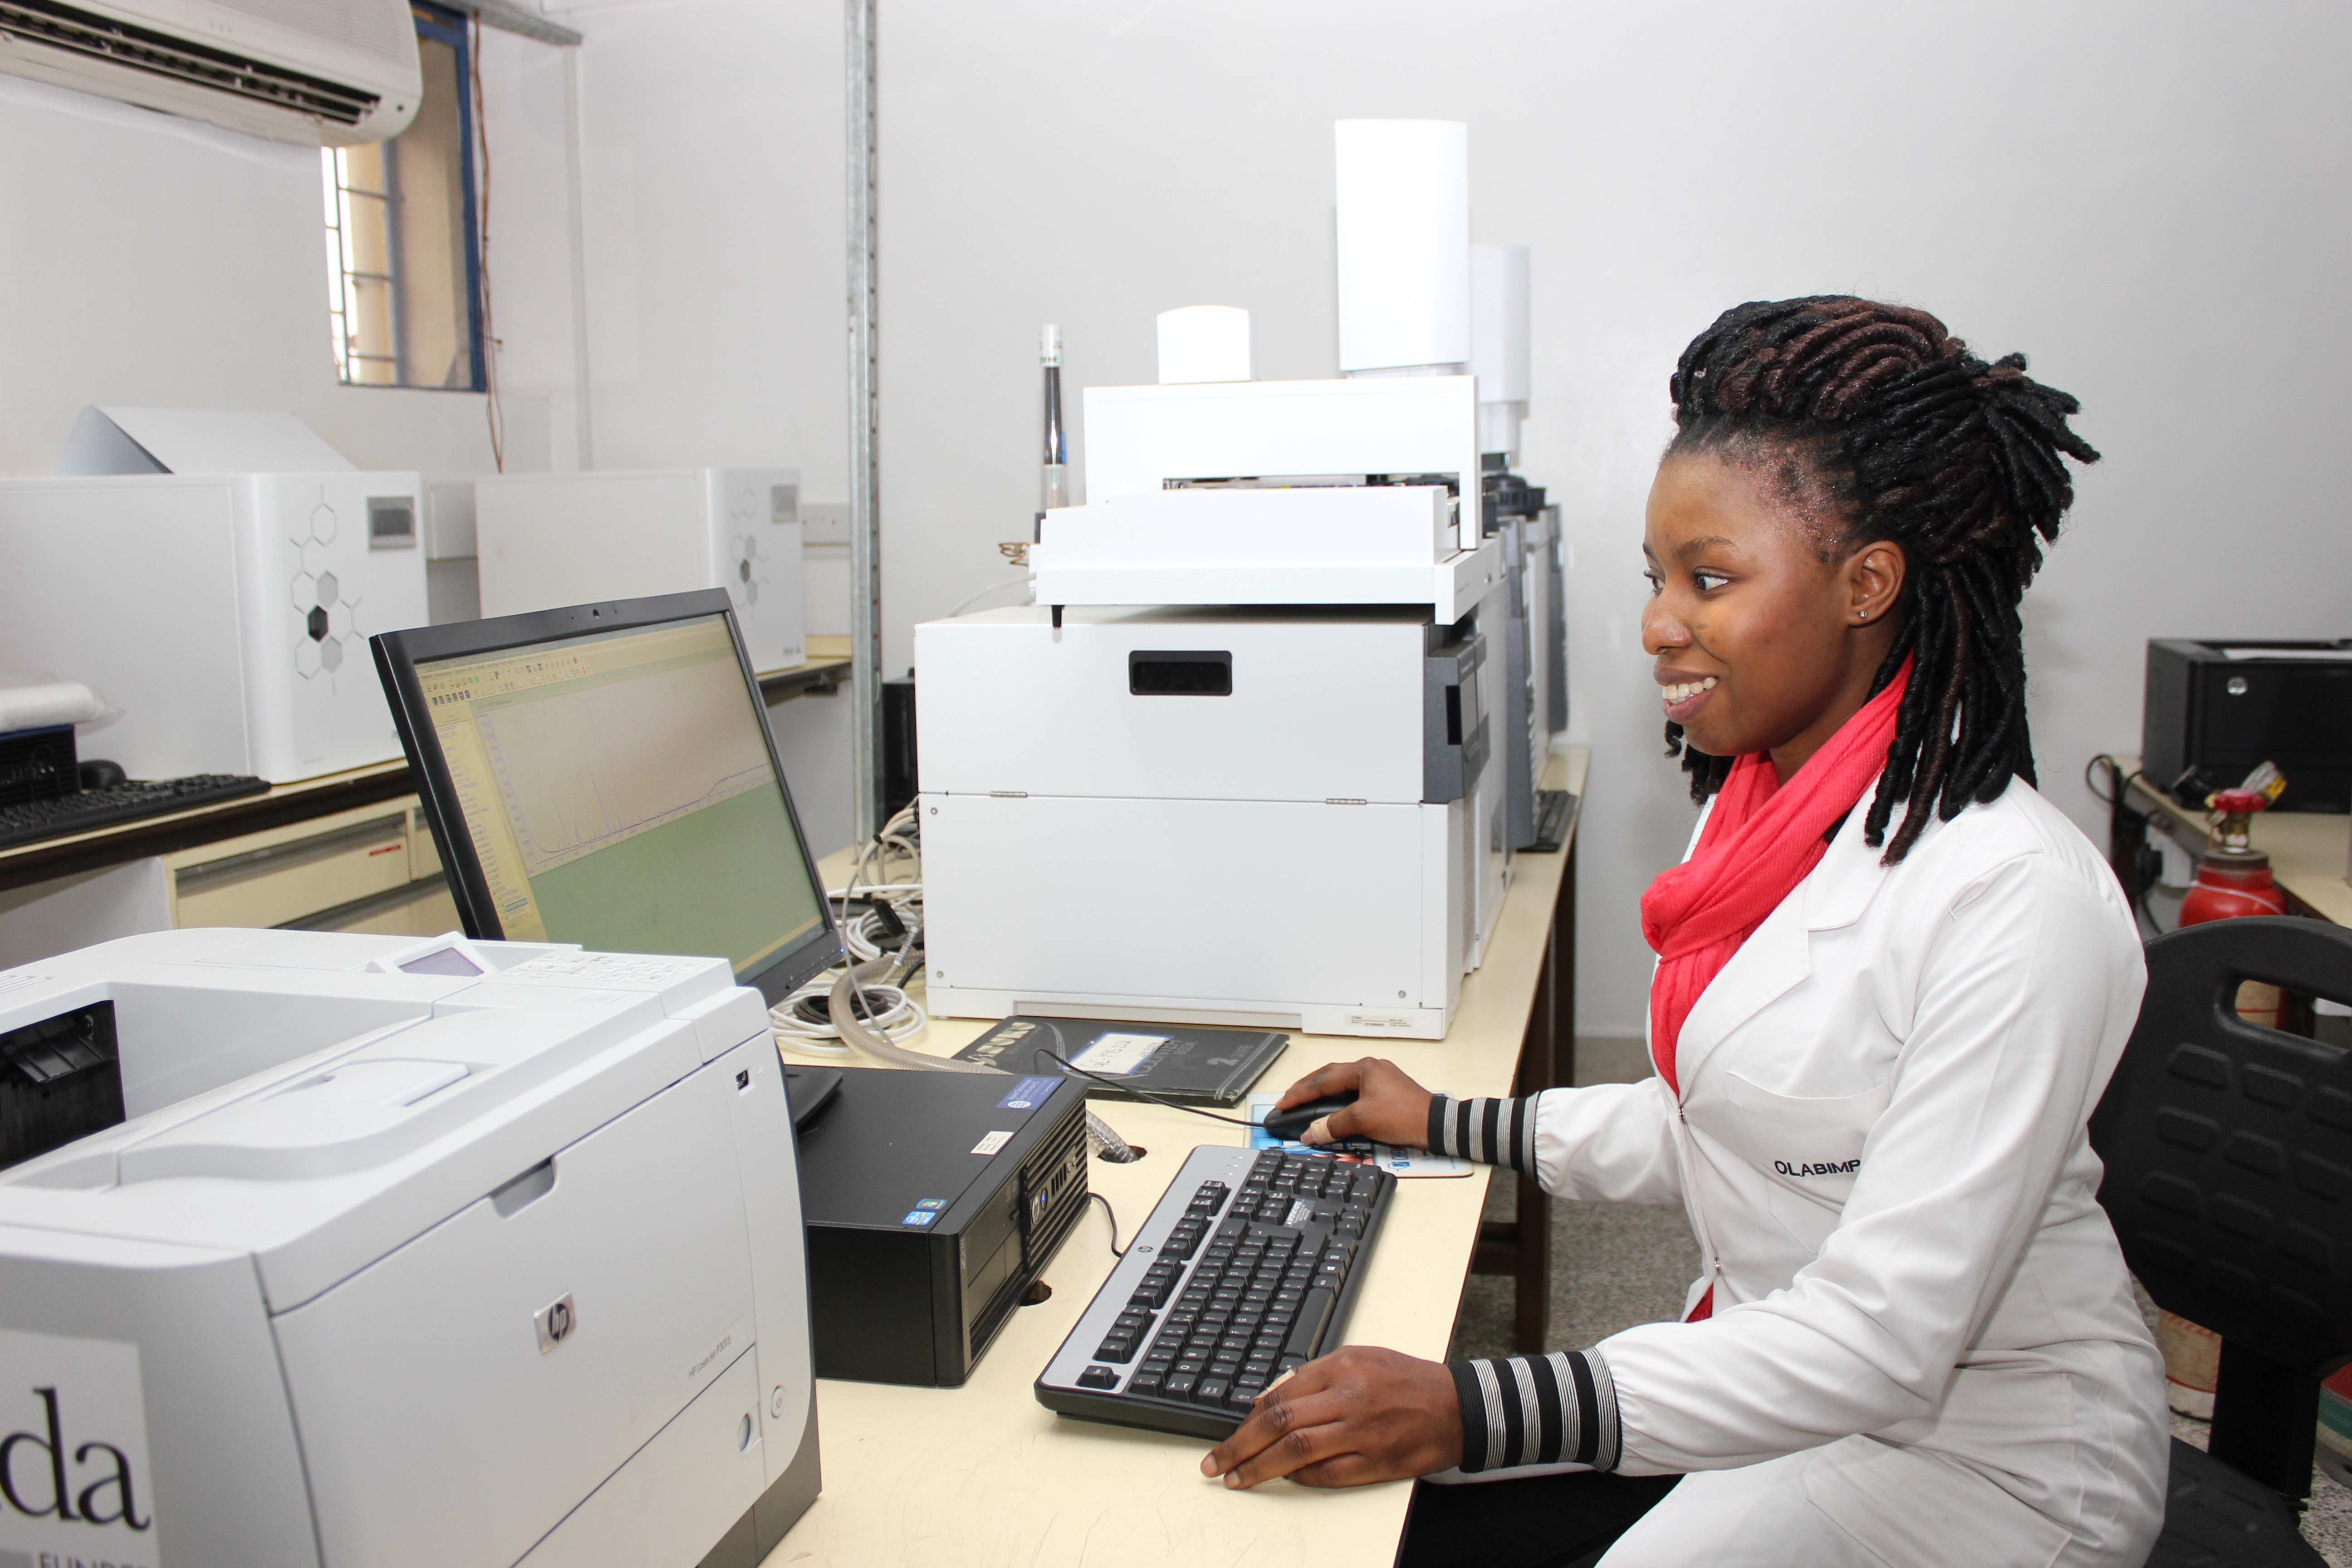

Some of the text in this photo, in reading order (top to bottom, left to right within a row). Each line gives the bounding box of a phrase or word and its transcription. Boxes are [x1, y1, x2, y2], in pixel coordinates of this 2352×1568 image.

[1207, 1058, 1239, 1066] 2
[1774, 1159, 1861, 1177] OLABIMP
[0, 1386, 151, 1532] da
